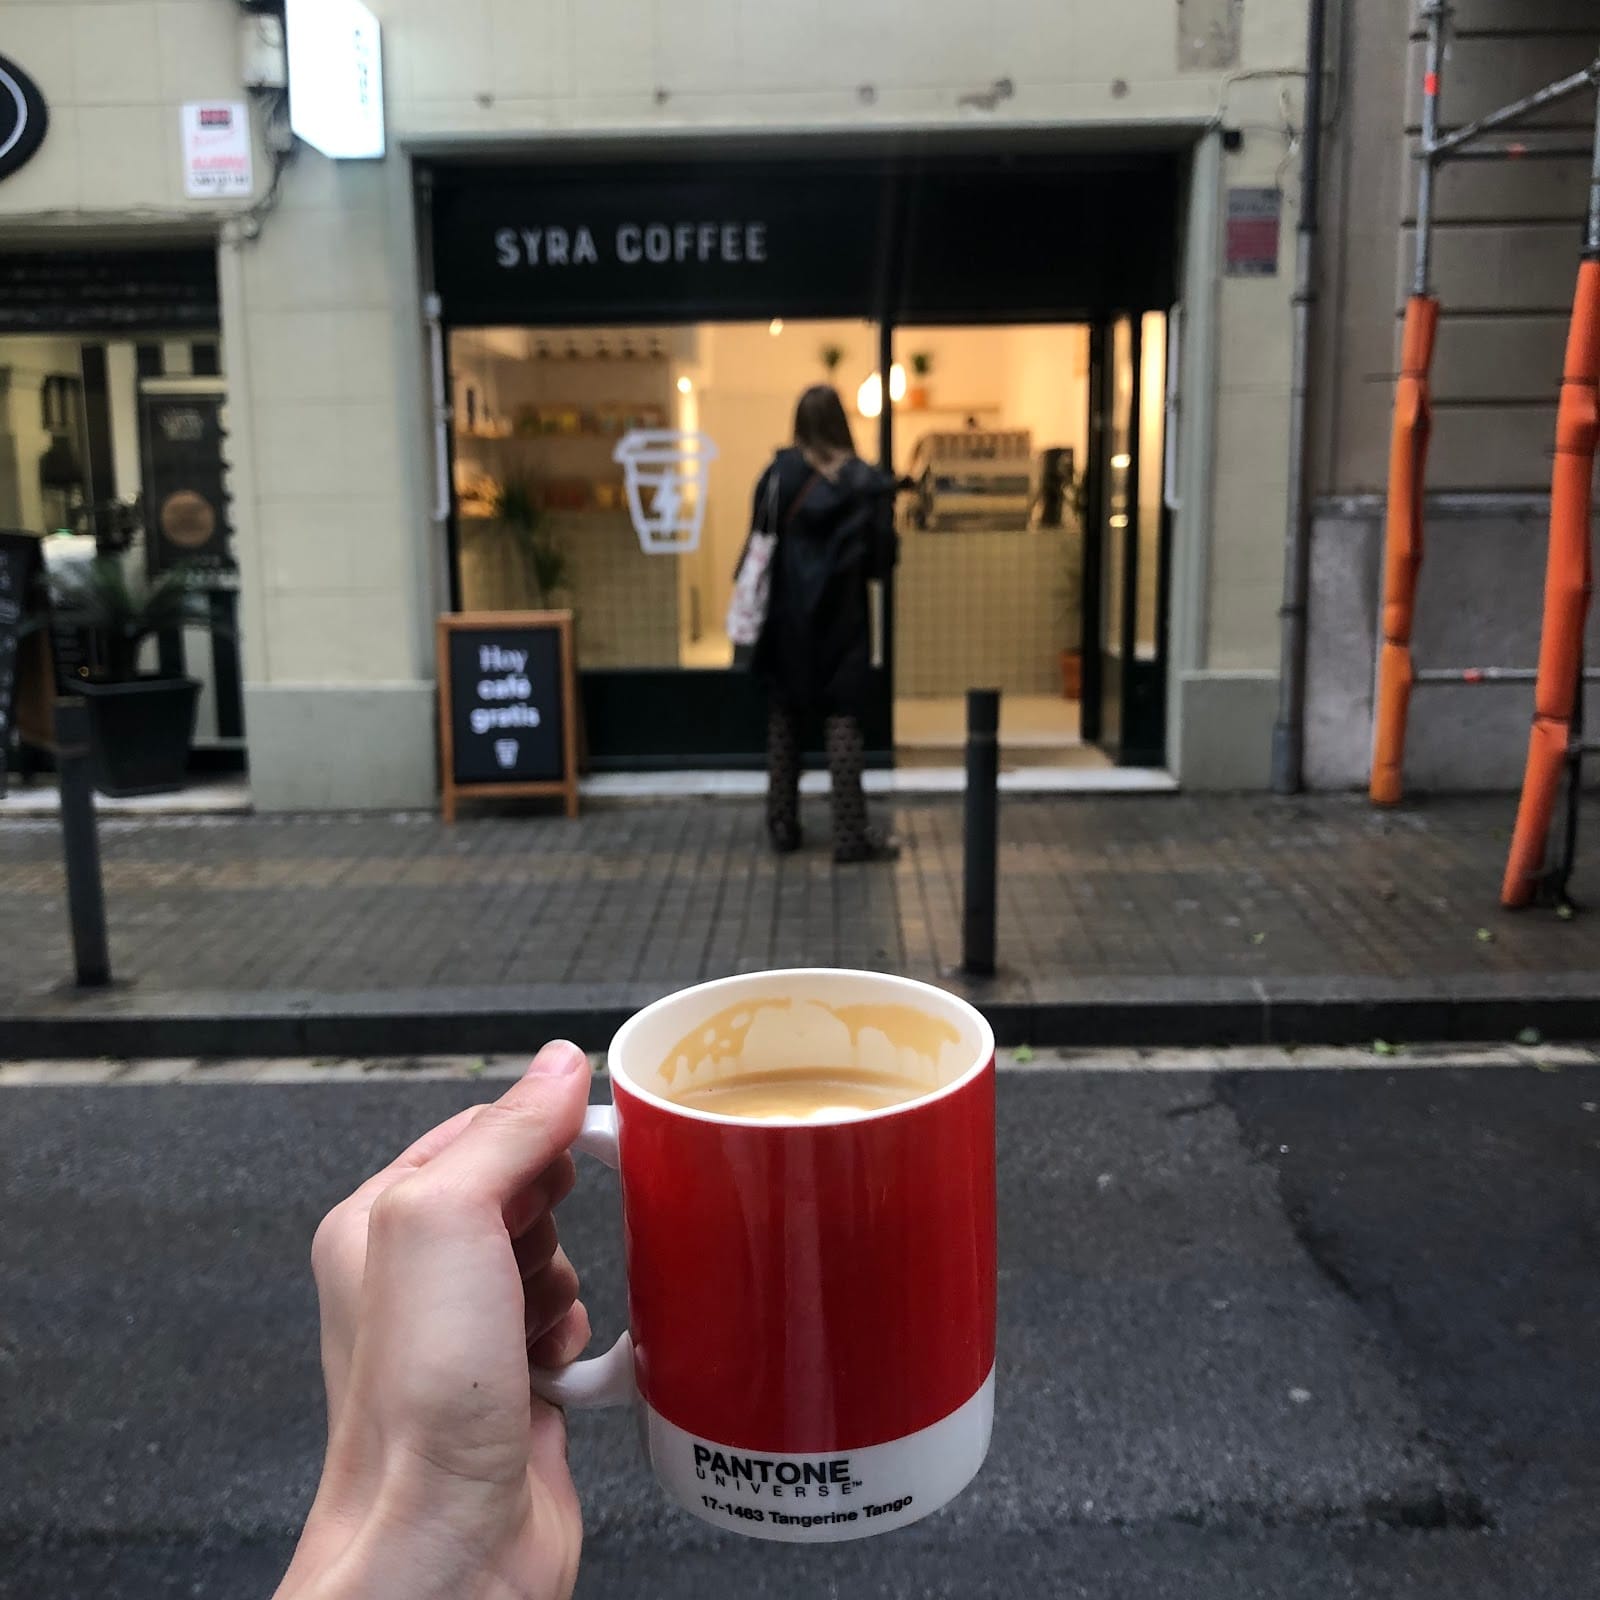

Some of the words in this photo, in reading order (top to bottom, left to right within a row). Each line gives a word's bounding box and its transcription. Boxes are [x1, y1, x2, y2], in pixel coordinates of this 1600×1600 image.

[495, 227, 597, 268] SYRA
[616, 222, 768, 264] COFFEE
[693, 1444, 850, 1484] PANTONE
[701, 1495, 764, 1522] 17-1463
[769, 1510, 858, 1528] Tangerine
[862, 1494, 913, 1518] Tango
